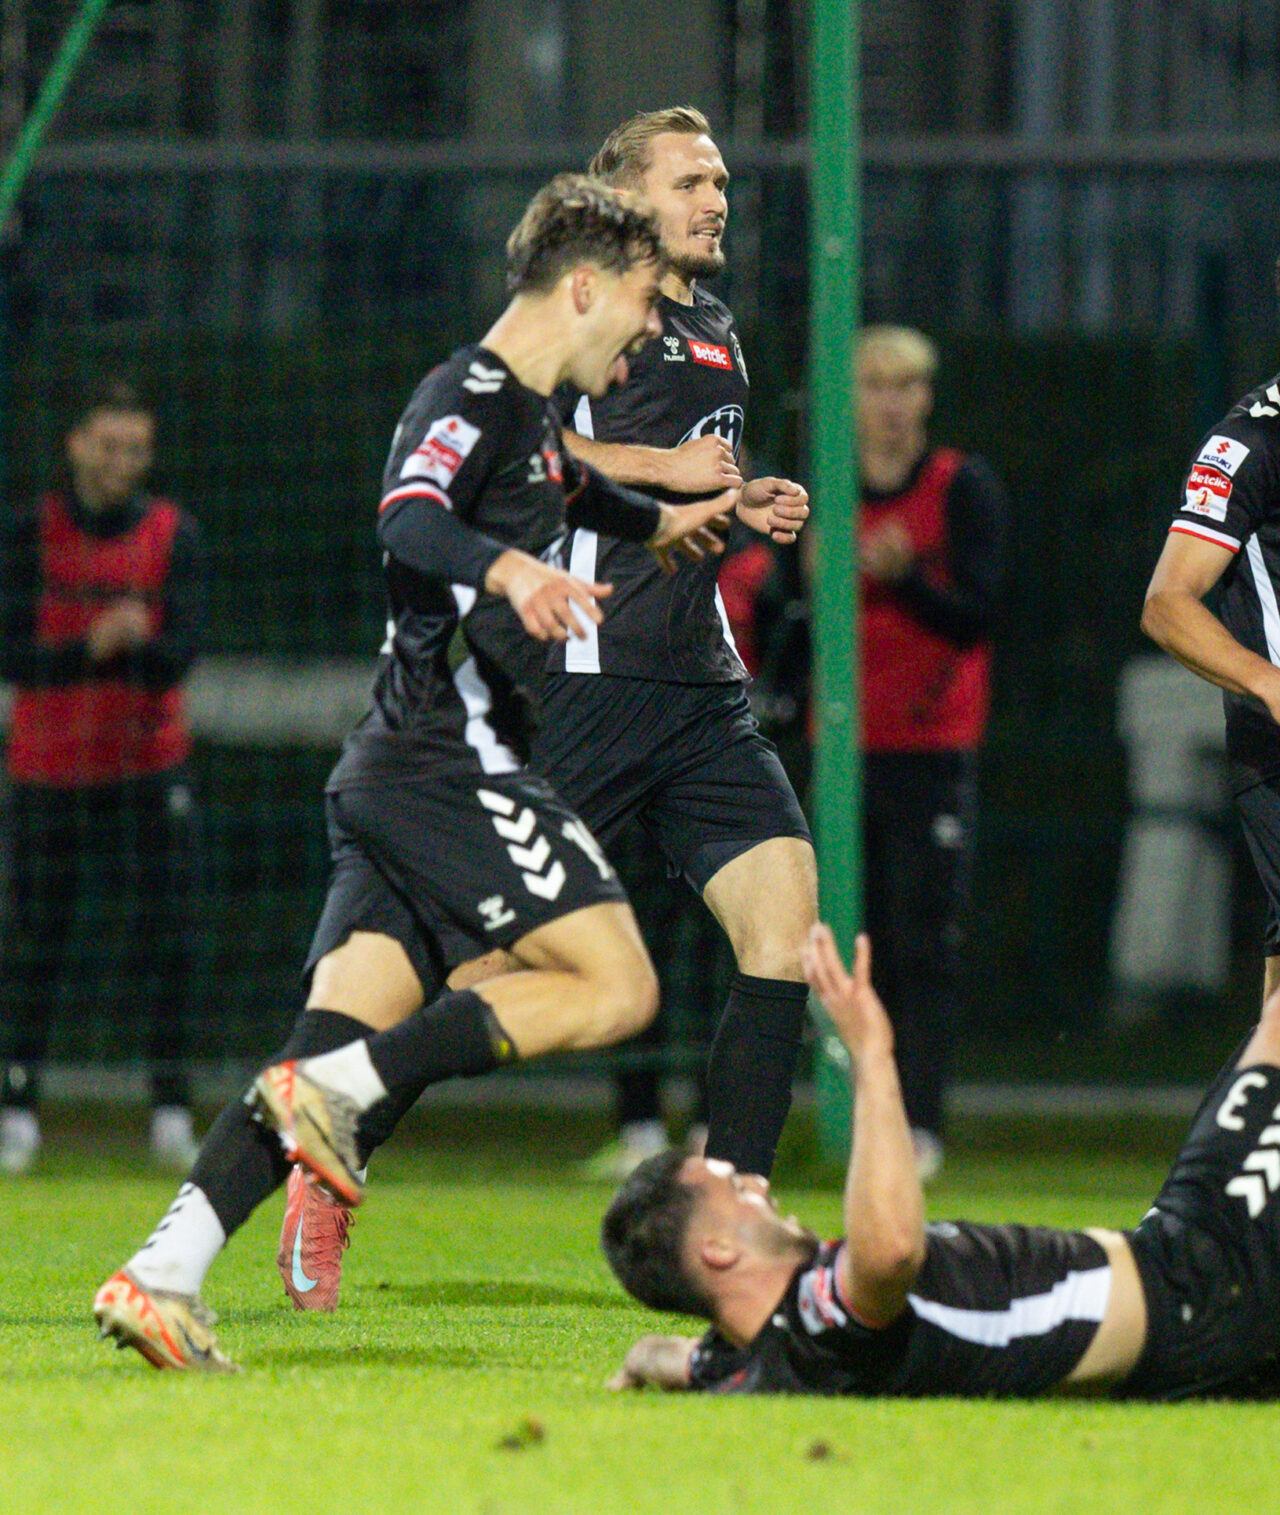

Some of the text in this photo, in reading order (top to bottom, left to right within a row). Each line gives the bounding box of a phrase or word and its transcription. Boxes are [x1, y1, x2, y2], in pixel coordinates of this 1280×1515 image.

[692, 344, 729, 366] Betclic
[1203, 454, 1232, 470] SUZUKI
[1190, 471, 1228, 490] Betclic
